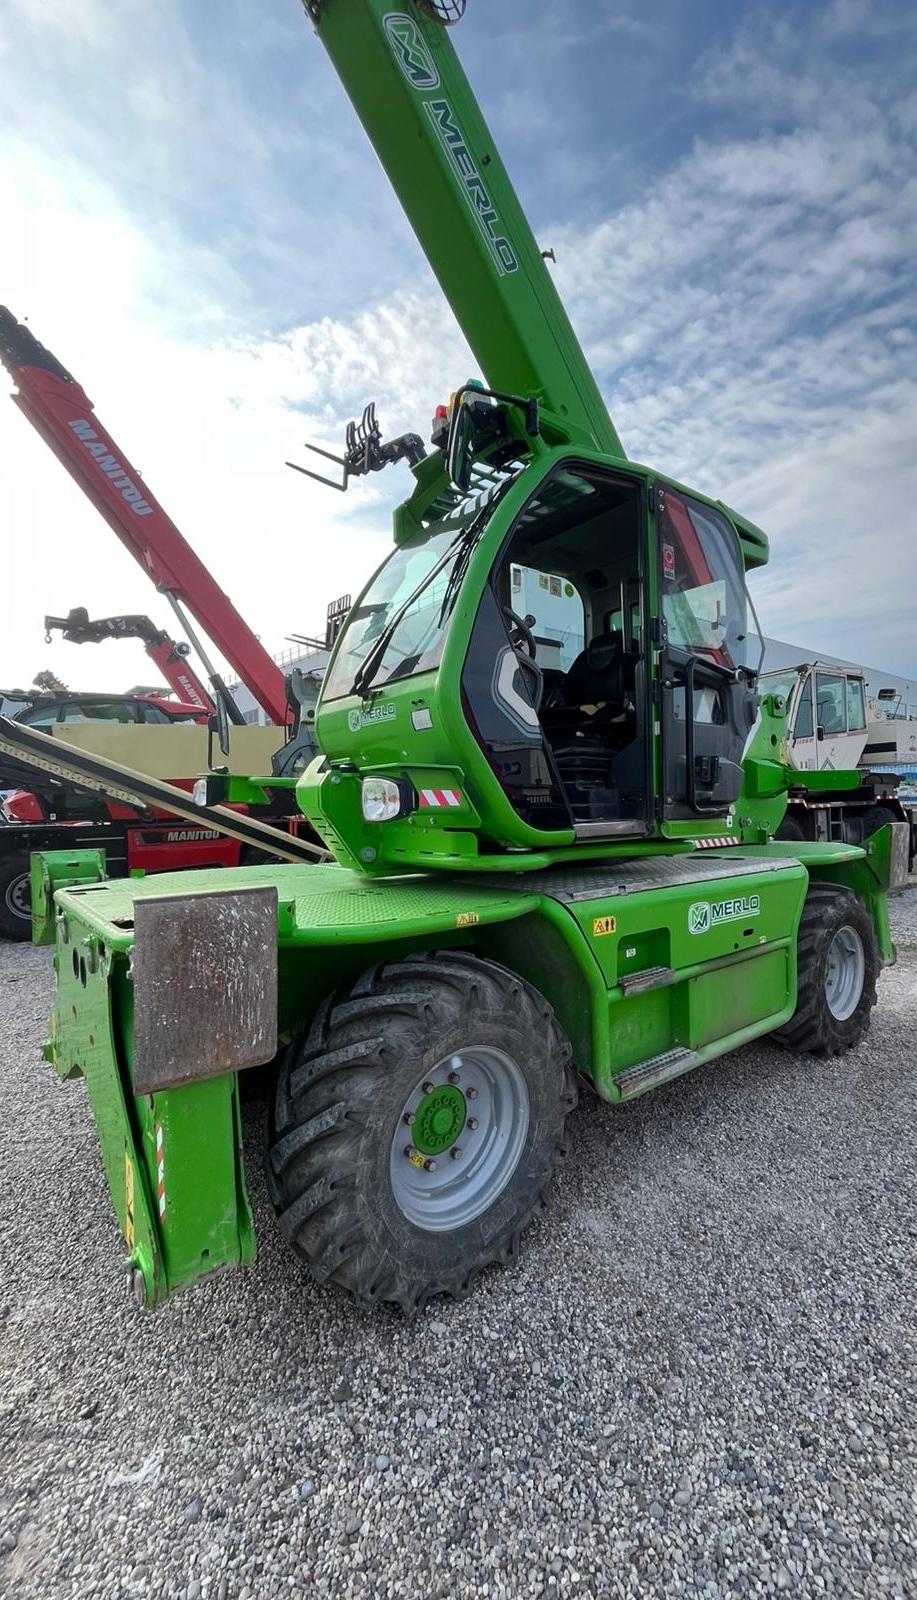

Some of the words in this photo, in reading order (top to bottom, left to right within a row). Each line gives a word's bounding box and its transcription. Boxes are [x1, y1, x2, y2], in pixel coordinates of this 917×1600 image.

[430, 100, 518, 274] MERLO
[68, 419, 153, 515] MANITOU
[177, 675, 204, 706] MANITO
[361, 703, 396, 720] MERLO
[167, 830, 220, 841] MANITOU
[711, 895, 760, 919] MERLO
